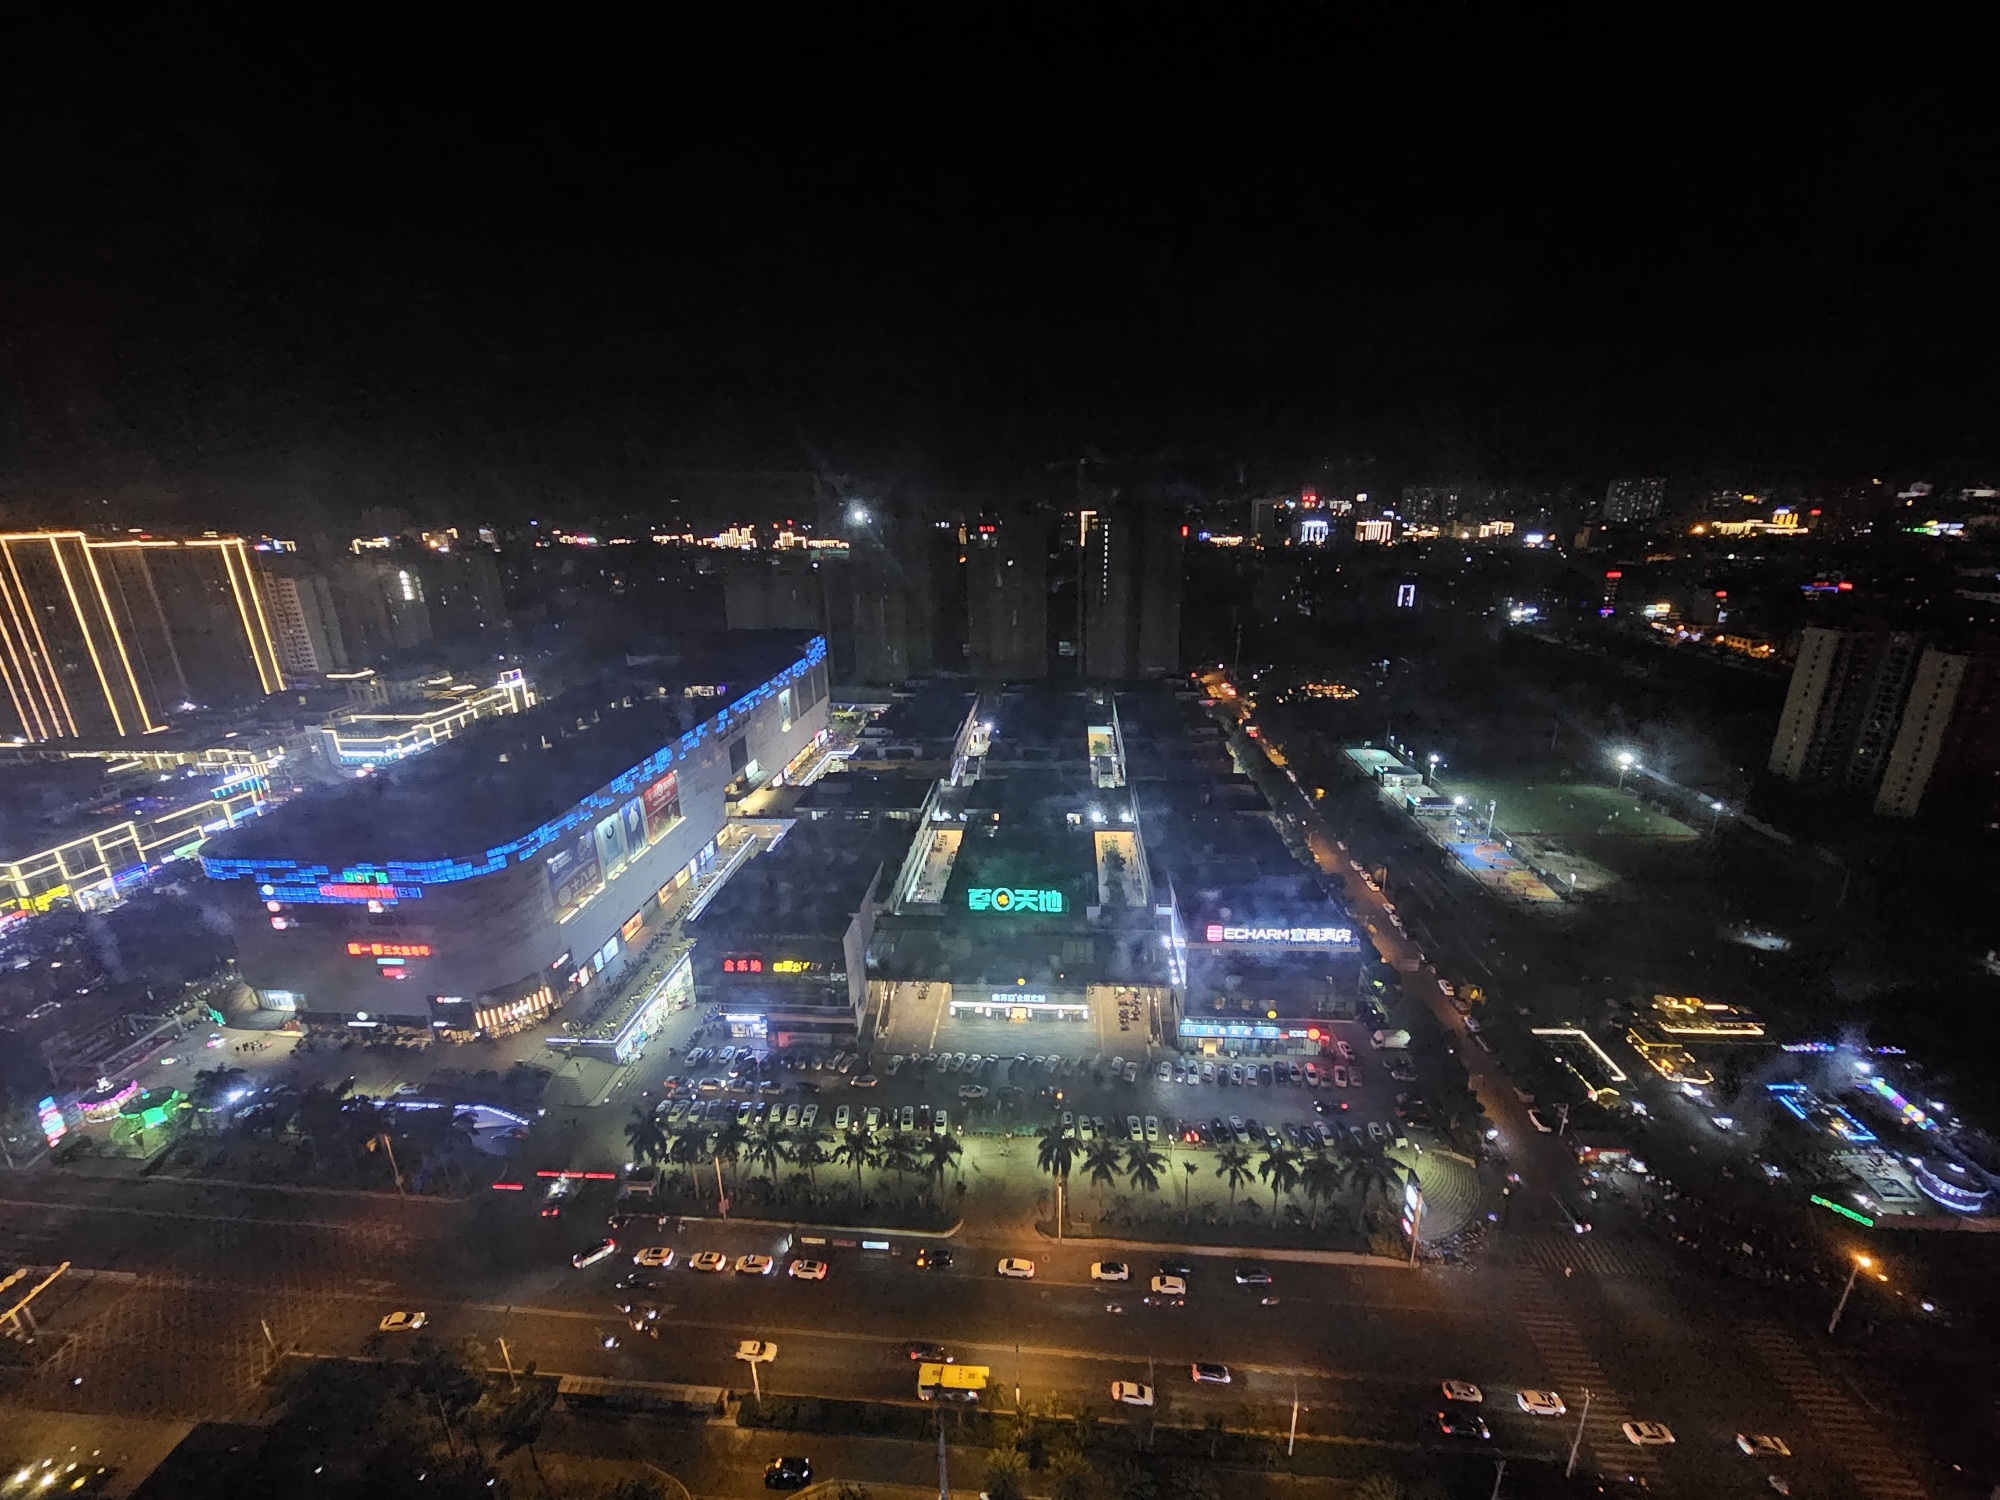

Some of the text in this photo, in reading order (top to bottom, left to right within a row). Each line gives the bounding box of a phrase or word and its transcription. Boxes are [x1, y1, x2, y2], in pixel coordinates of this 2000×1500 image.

[1224, 927, 1352, 943] ECHARM 宜尚酒店
[1288, 1029, 1308, 1038] ICBC
